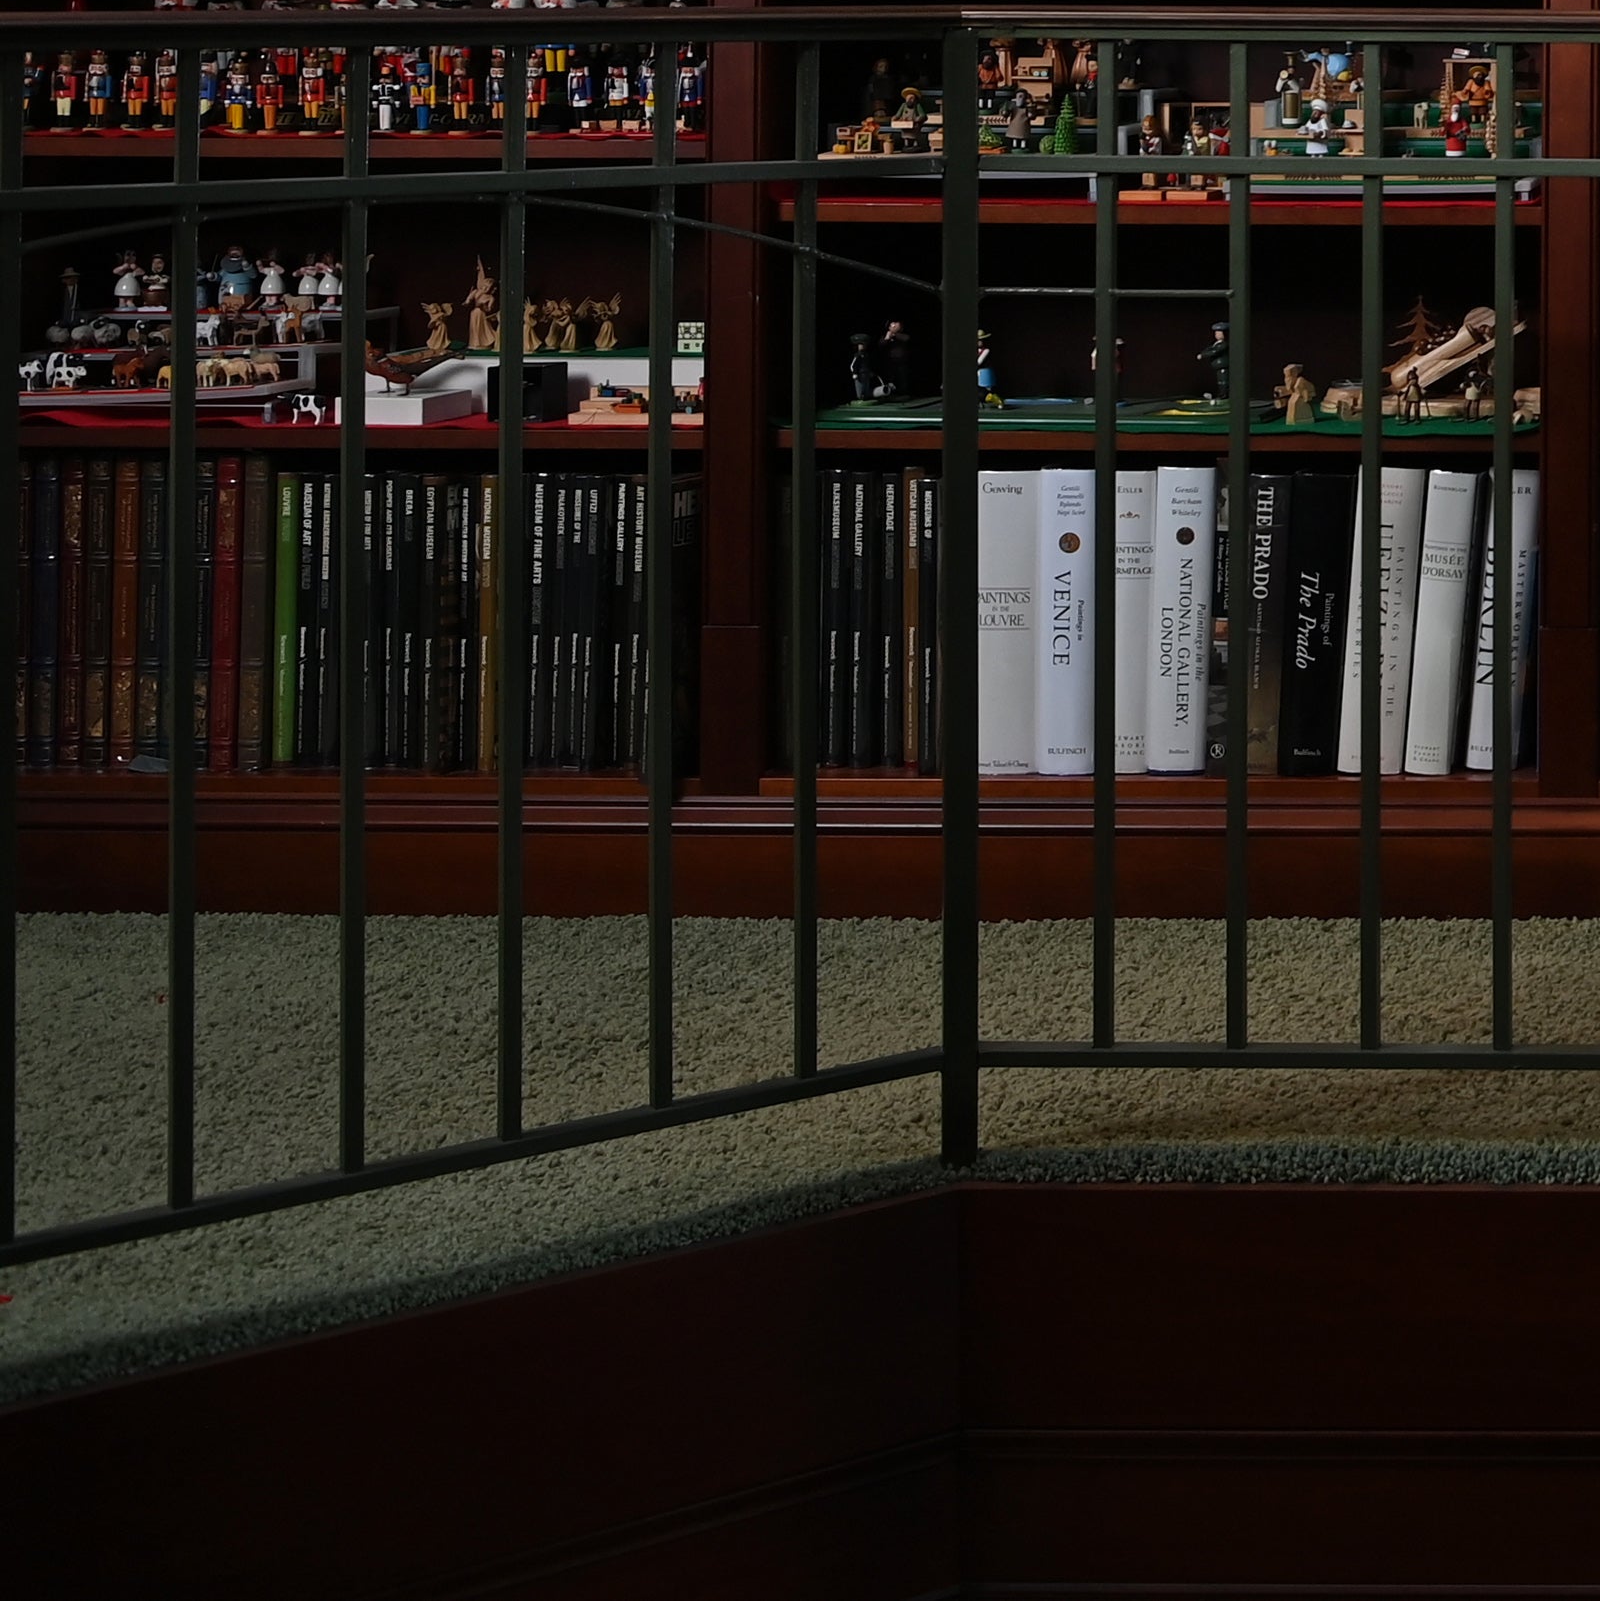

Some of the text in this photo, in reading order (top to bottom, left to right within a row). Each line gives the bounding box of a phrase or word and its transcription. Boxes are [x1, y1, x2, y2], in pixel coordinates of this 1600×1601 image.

[282, 487, 290, 516] LOUVRE
[302, 483, 311, 546] MUSEUM OF ART
[425, 487, 434, 559] EGYPTIAN MUSEUM
[482, 488, 491, 559] NATIONAL MUSEUM
[853, 484, 864, 556] NATIONAL GALLERY
[885, 484, 894, 531] HERMITAGE
[908, 479, 917, 547] VATICAN MUSEUMS
[983, 482, 1023, 495] Gowing
[532, 484, 543, 584] MUSEUM OF FINE ARTS
[634, 486, 644, 571] ART HISTORY MUSEUM
[1251, 487, 1274, 599] THE PRADO
[1425, 554, 1465, 566] MUSÉE
[1053, 570, 1071, 666] VENICE
[1159, 607, 1173, 677] LONDON
[1174, 559, 1193, 727] NATIONAL GALLERY,
[1195, 604, 1206, 682] Paintings in the
[1295, 571, 1320, 669] The Prado
[1321, 593, 1335, 646] Paintings of
[1385, 547, 1405, 718] PAINTINGS IN THE
